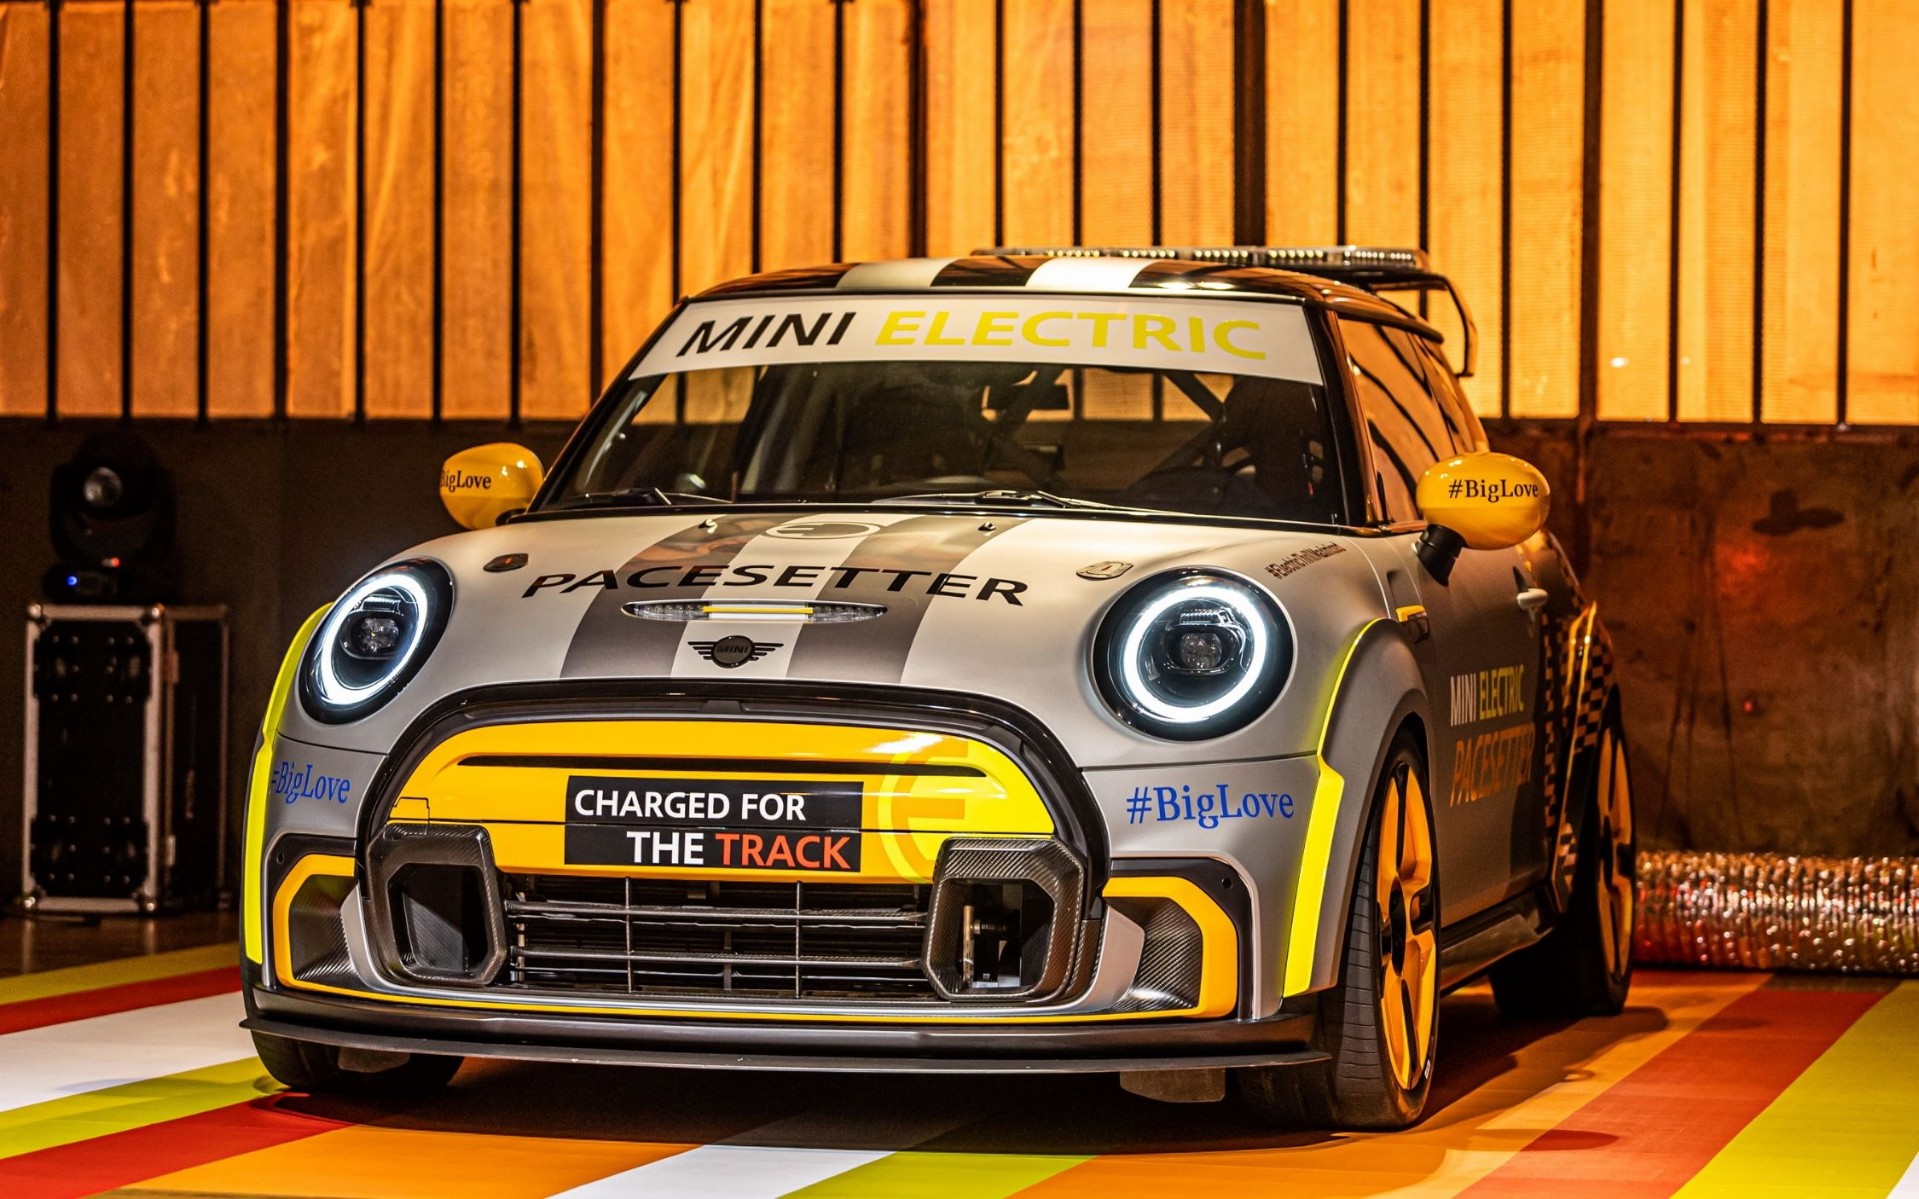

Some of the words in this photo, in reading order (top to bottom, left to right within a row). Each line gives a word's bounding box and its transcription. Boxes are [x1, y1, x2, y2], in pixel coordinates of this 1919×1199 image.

[676, 311, 857, 357] MINI
[874, 310, 1267, 360] ELECTRIC
[1448, 479, 1539, 503] #BigLove
[521, 564, 1028, 606] PACESETTER
[715, 644, 749, 654] MINI
[1450, 673, 1477, 726] MINI
[1479, 664, 1524, 720] ELECTRIC
[1450, 722, 1535, 808] PACESETTER
[574, 789, 730, 819] CHARGED
[741, 794, 806, 820] FOR
[1126, 784, 1295, 829] #BigLove
[626, 831, 704, 865] THE
[714, 833, 851, 869] TRACK
